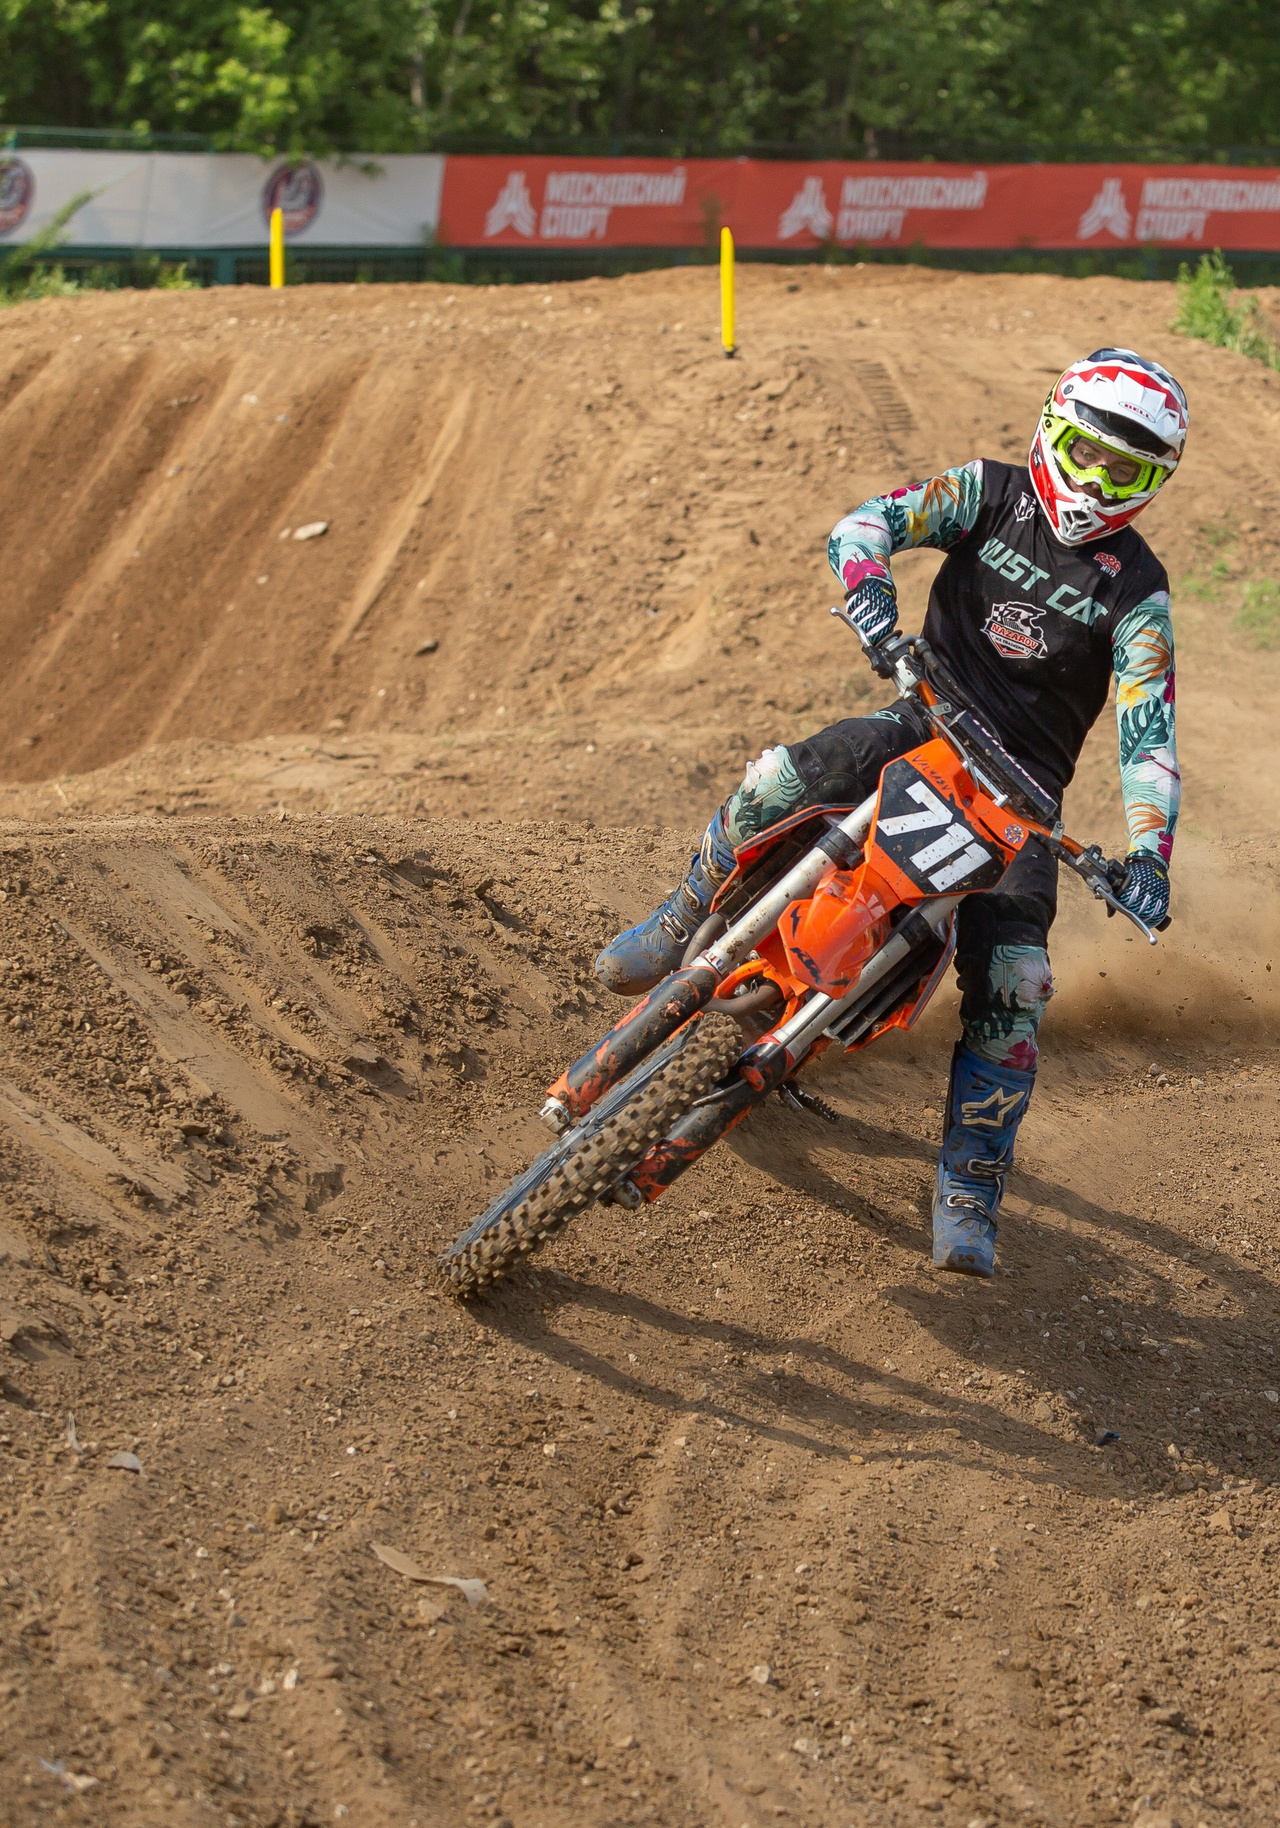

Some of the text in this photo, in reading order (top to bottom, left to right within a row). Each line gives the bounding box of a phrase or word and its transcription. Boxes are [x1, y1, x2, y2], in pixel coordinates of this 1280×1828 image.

[544, 166, 687, 206] МОСКОВСКИЙ
[840, 171, 988, 210] МОСКОВСКИЙ
[540, 206, 612, 239] СПОРТ
[1046, 584, 1109, 626] CAT
[991, 622, 1039, 650] NAZAROV
[877, 780, 992, 893] 711
